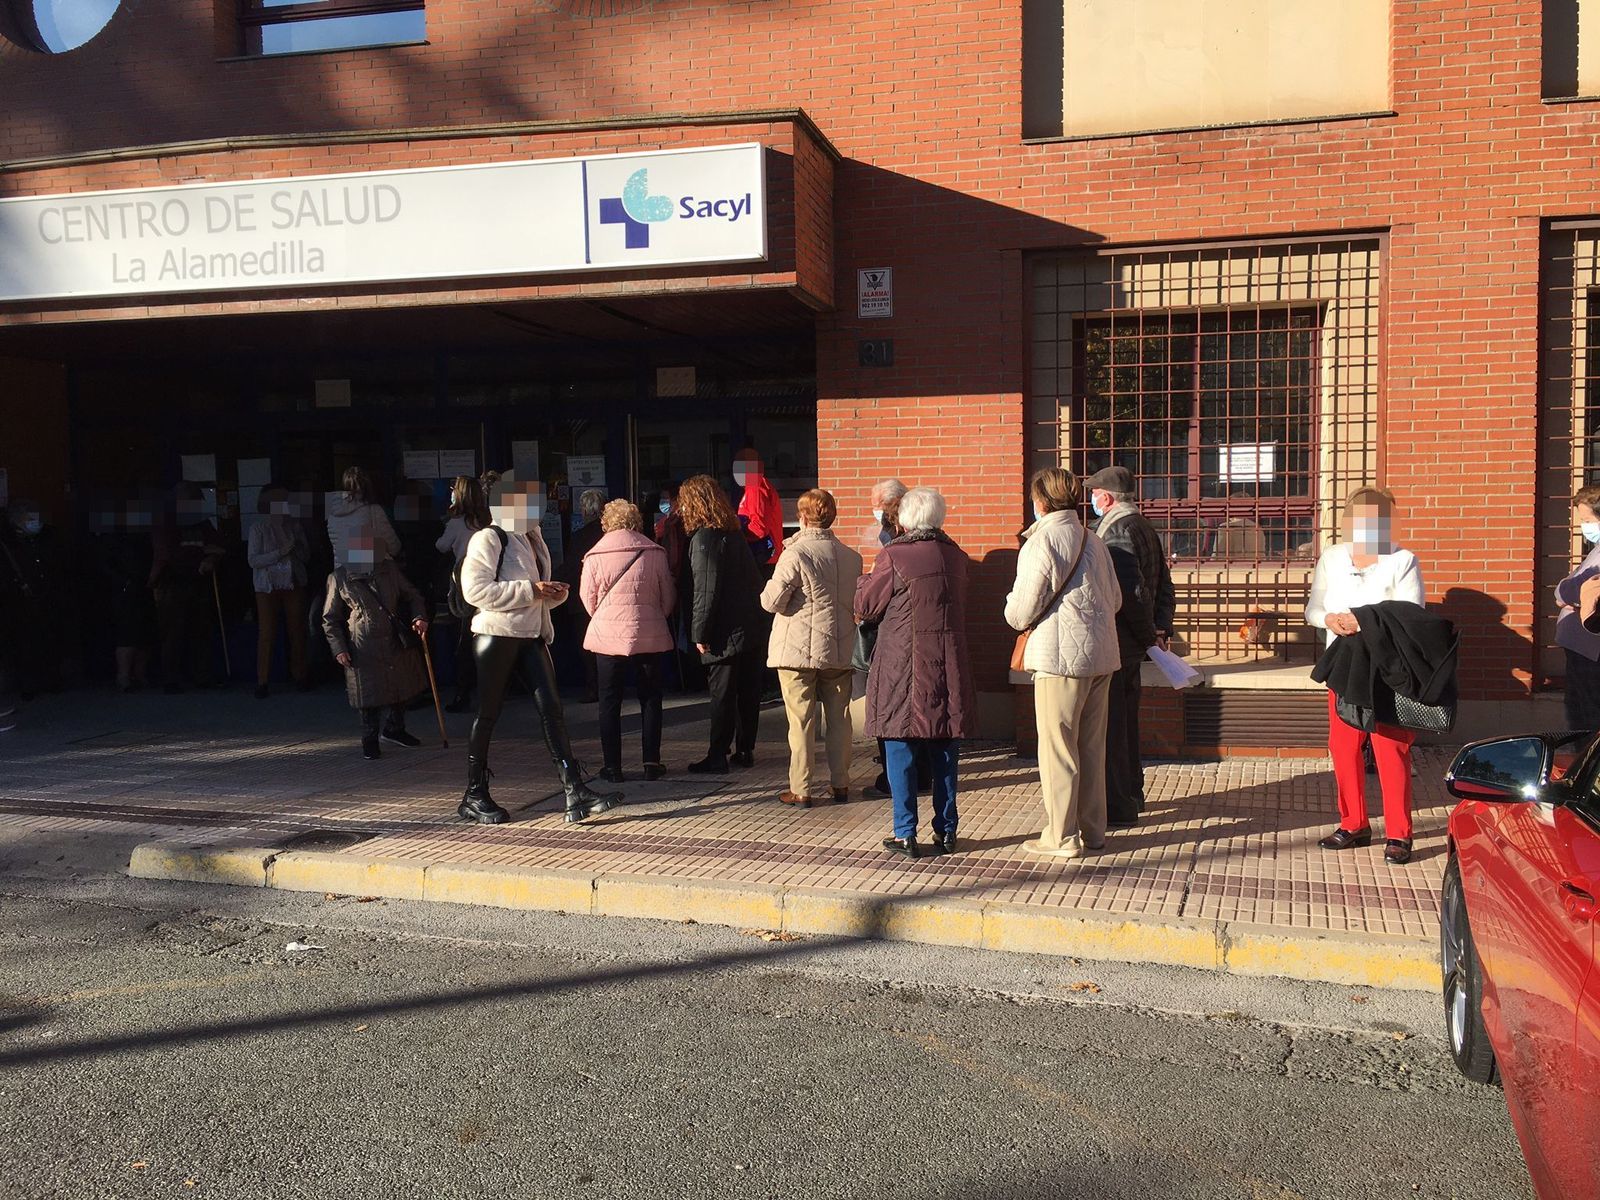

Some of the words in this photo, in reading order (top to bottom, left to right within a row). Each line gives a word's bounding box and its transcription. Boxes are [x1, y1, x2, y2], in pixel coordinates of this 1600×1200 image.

[38, 198, 190, 244] CENTRO
[204, 194, 257, 234] DE
[270, 184, 402, 230] SALUD
[680, 193, 751, 222] Sacyl
[112, 252, 146, 283] La
[158, 240, 325, 281] Alamedilla
[863, 341, 887, 364] 31
